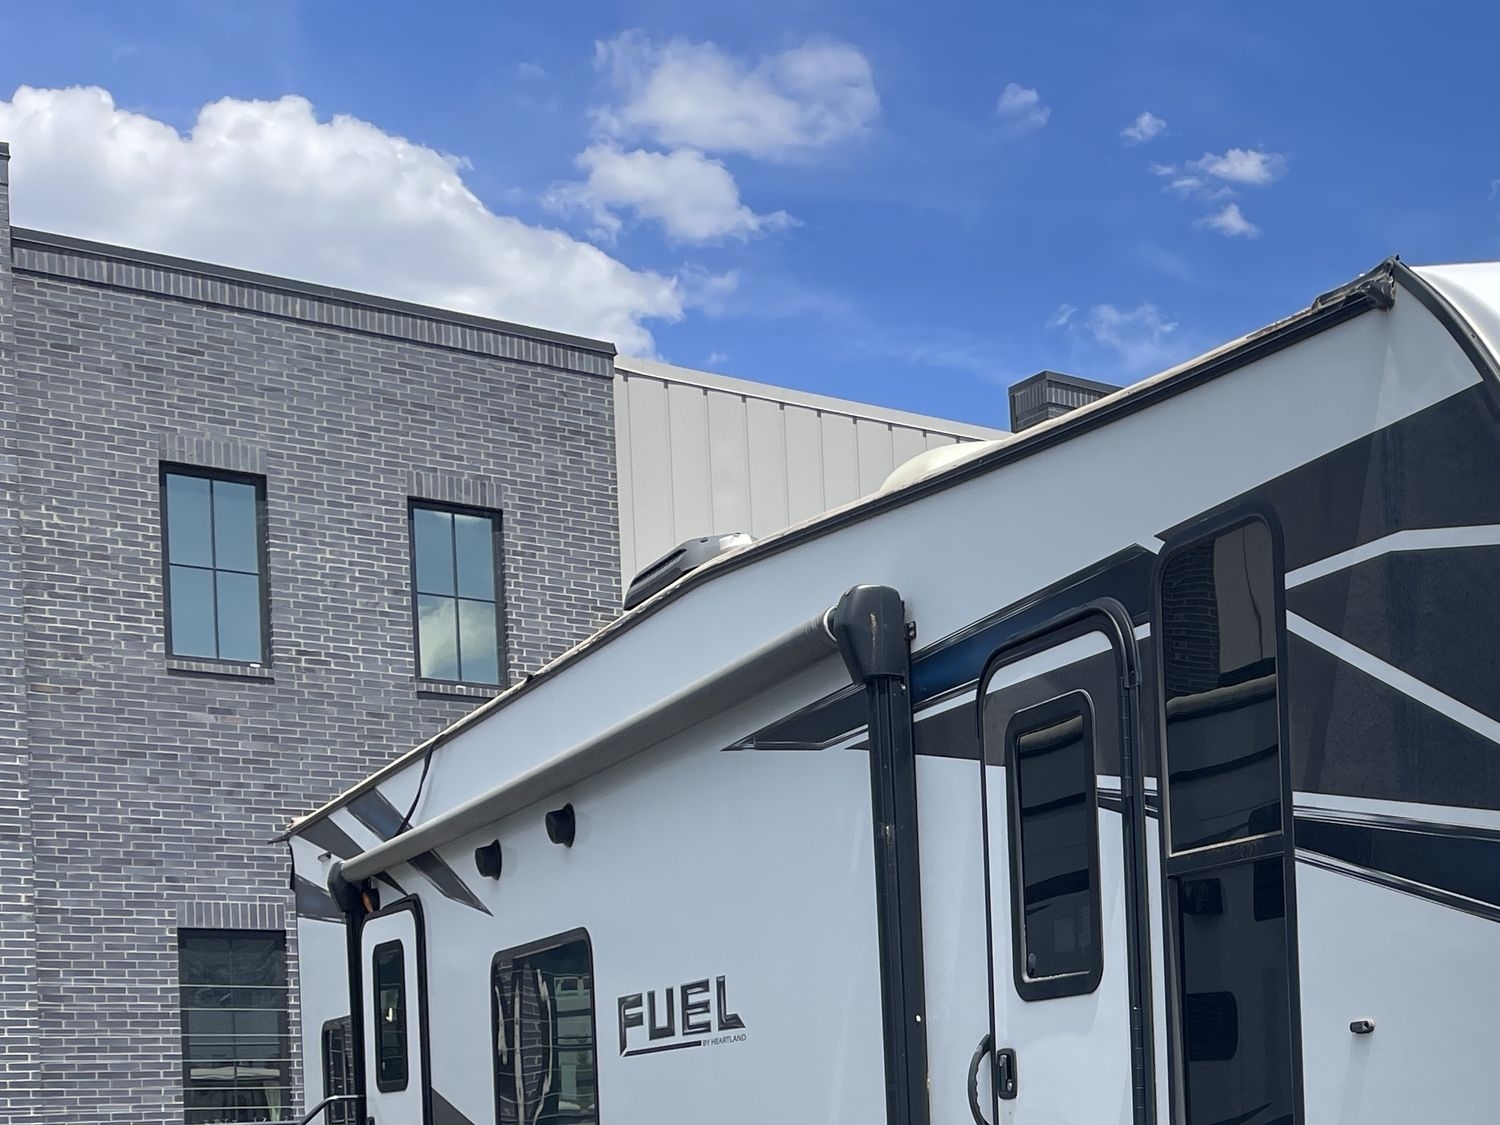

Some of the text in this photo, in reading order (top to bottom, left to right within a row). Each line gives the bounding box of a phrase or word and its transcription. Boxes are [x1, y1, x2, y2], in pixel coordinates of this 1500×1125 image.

[617, 975, 747, 1057] FUEL
[702, 1034, 747, 1047] BY HEARTLAND
